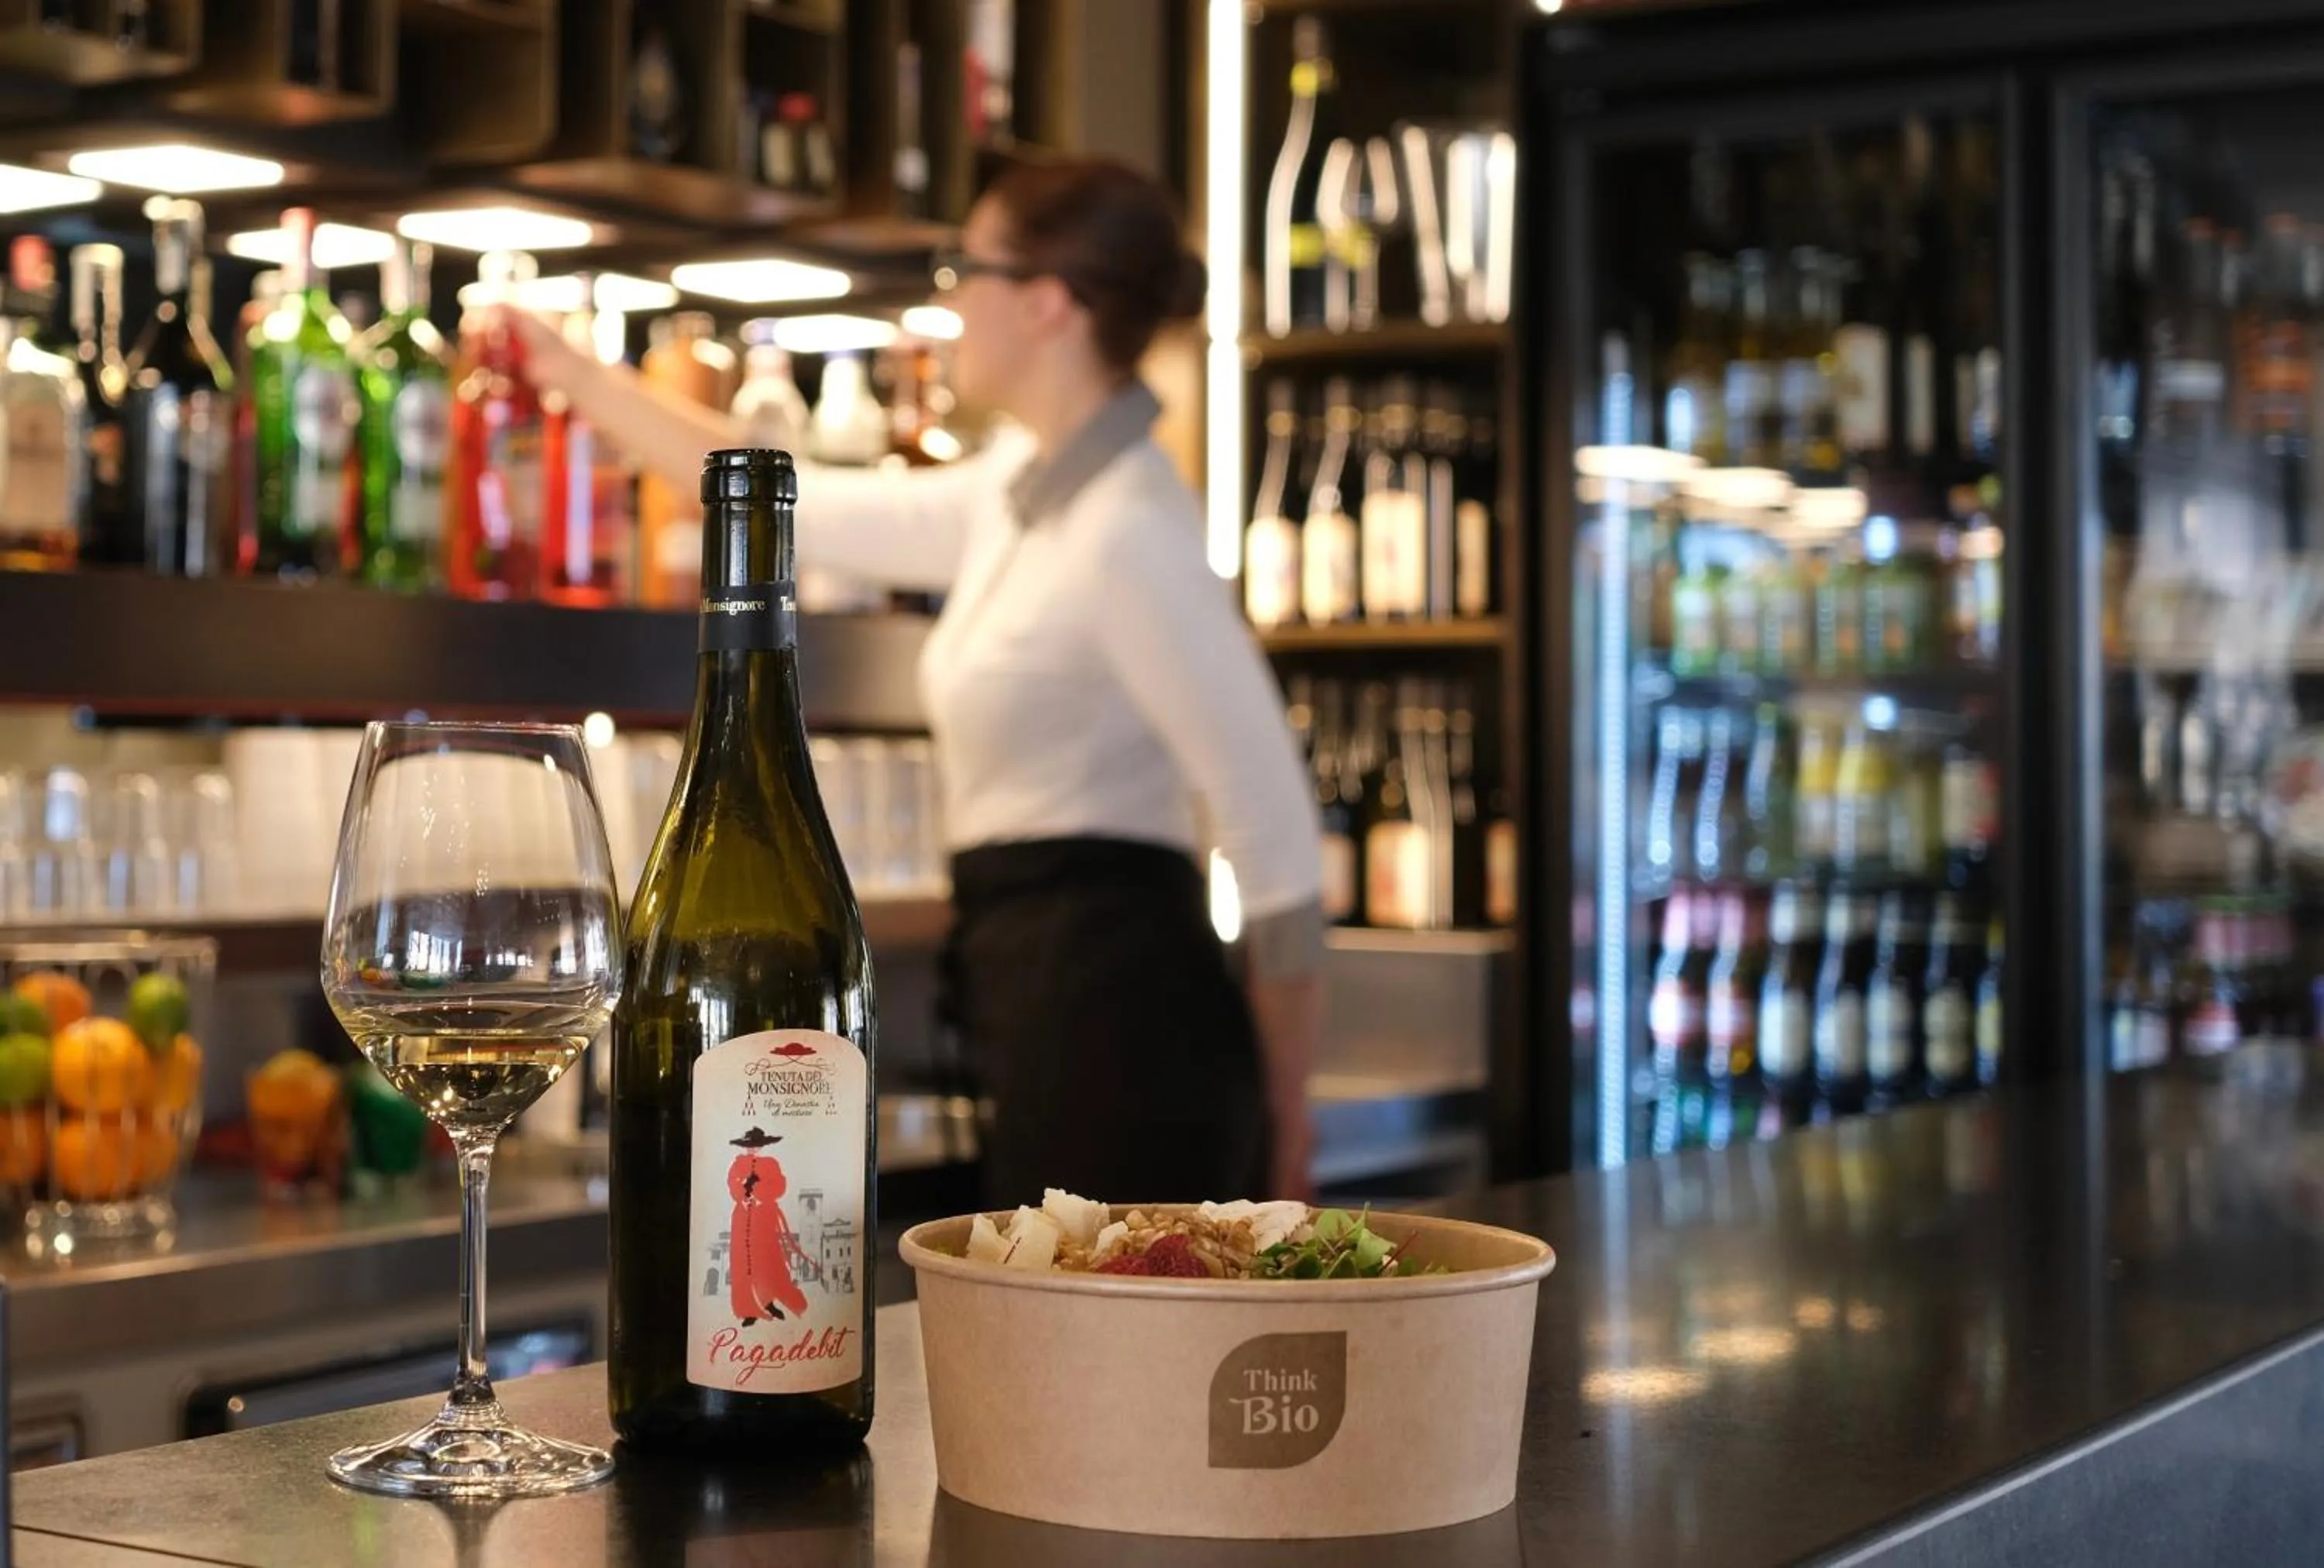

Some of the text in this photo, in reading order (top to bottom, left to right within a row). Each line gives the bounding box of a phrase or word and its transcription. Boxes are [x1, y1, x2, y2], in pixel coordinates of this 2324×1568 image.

[760, 1071, 803, 1082] TENUTA
[709, 1326, 855, 1385] Pagadebit
[1243, 1368, 1318, 1391] Think
[1229, 1394, 1319, 1435] Bio
